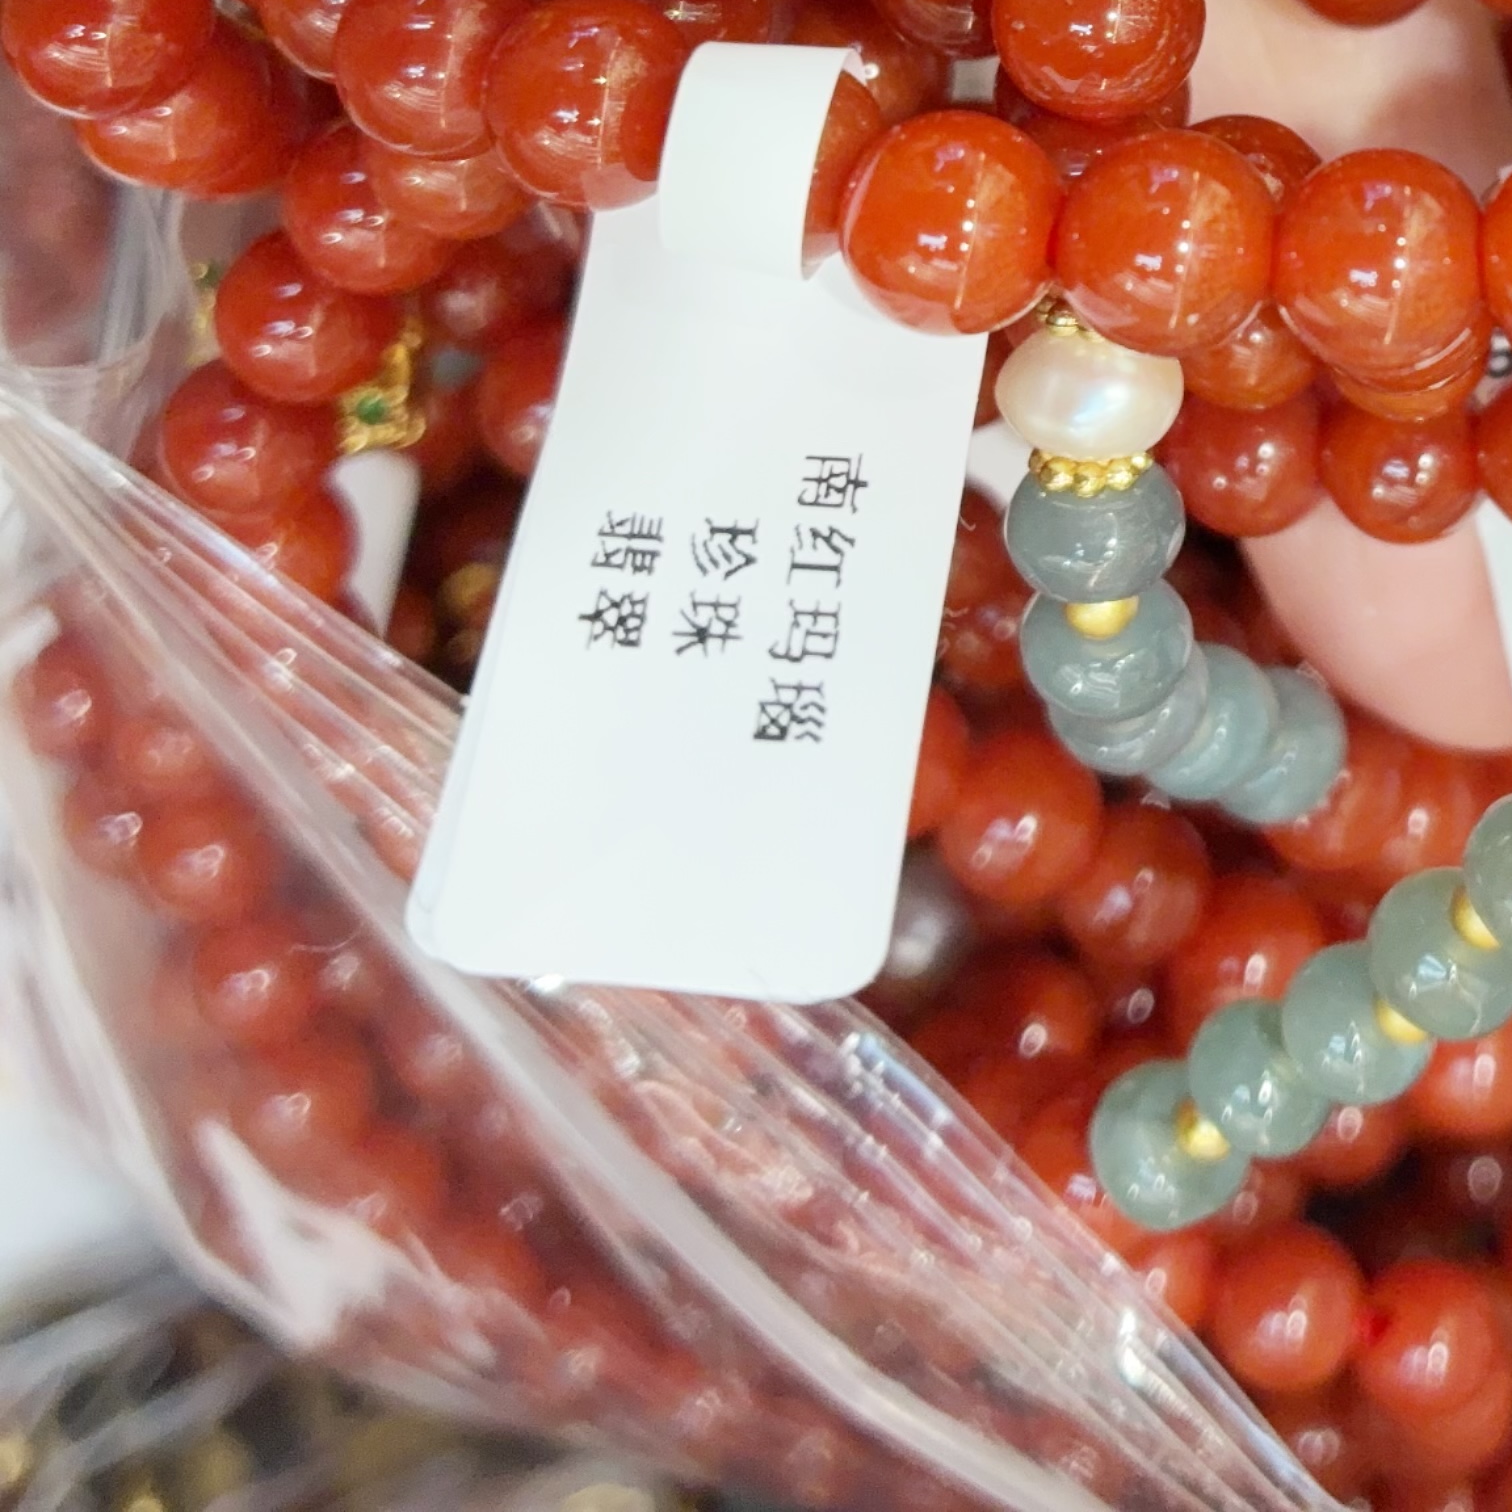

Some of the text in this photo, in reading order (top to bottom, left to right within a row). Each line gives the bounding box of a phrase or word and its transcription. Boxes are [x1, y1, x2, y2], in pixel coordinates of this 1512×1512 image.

[577, 509, 665, 651] 翡翠
[672, 518, 758, 656] 珍珠
[753, 454, 868, 742] 南红玛瑙
